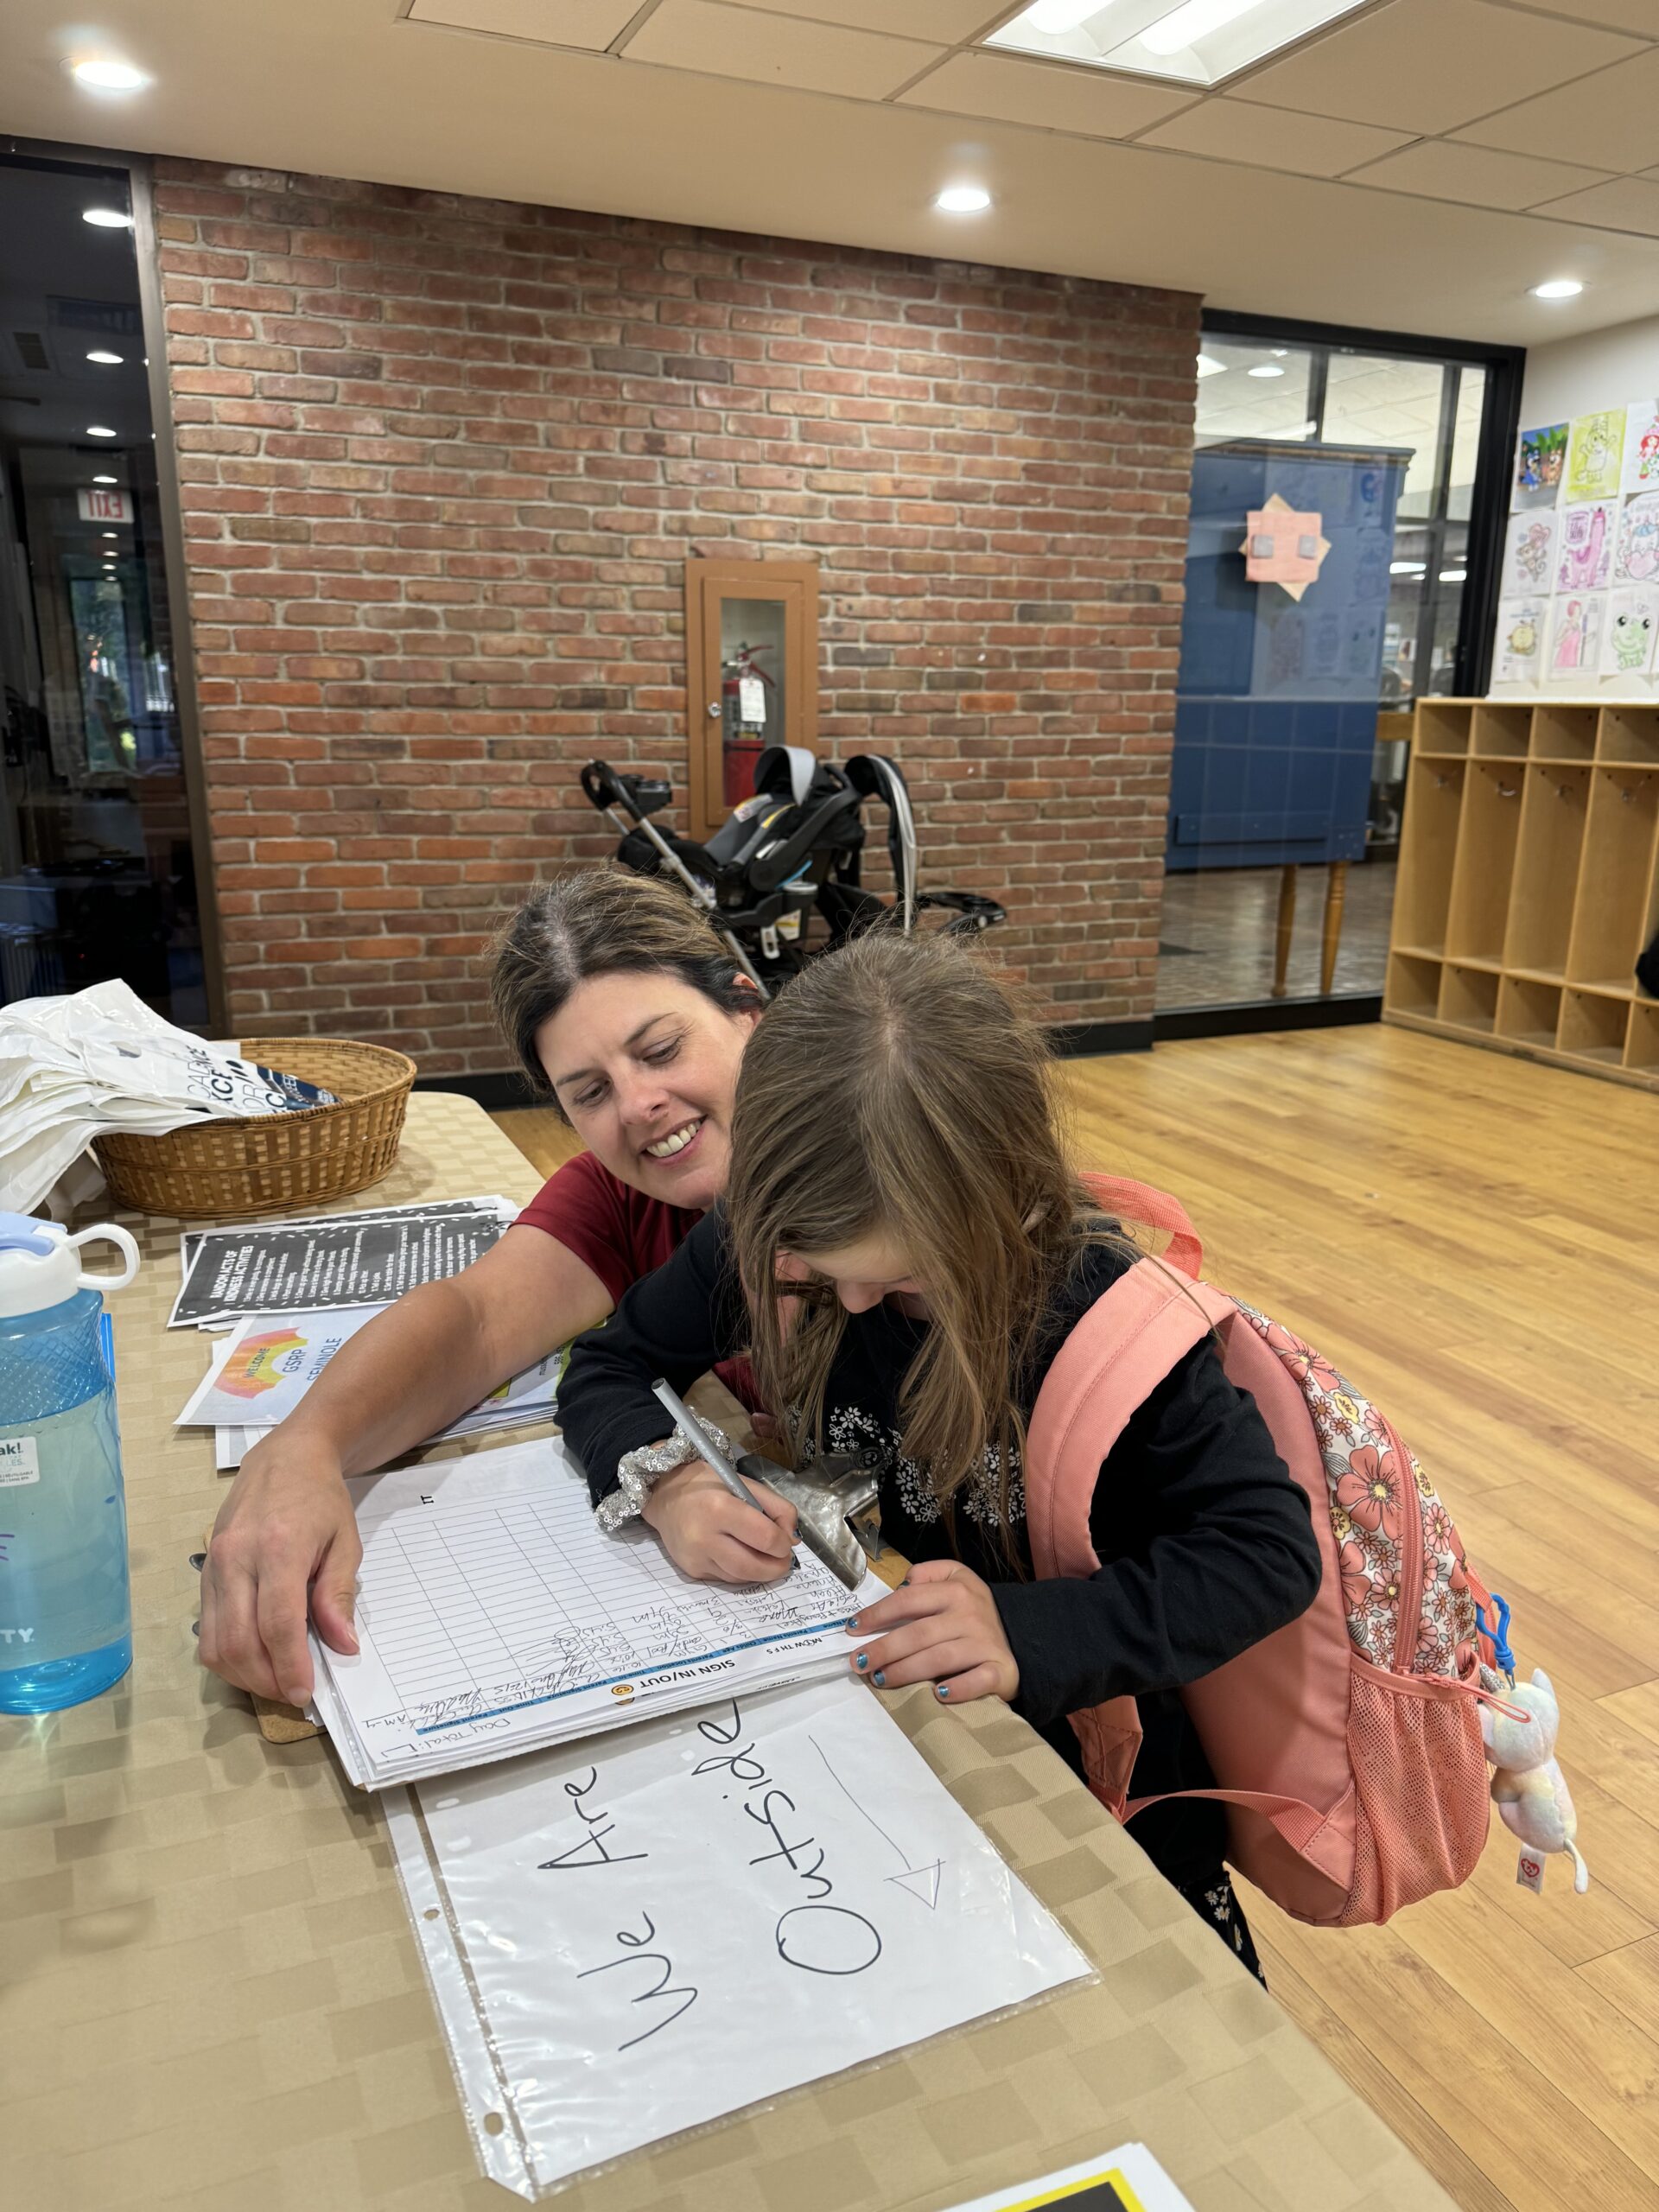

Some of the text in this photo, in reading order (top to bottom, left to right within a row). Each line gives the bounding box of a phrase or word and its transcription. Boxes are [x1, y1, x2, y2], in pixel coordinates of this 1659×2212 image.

[209, 1274, 229, 1298] RANDOM
[219, 1258, 235, 1273] ACTS
[224, 1245, 253, 1301] KINDNESS ACTIVITIES
[244, 1347, 270, 1378] WELCOME
[283, 1349, 307, 1373] GSRP
[307, 1337, 341, 1381] SEMINOLE
[0, 1442, 21, 1455] ak!
[0, 1628, 34, 1643] TY
[640, 1659, 734, 1688] SIGN IN/OUT
[657, 1660, 686, 1669] Location
[546, 1680, 607, 1699] Parent Signature
[423, 1713, 486, 1732] Parent Signature
[468, 1718, 510, 1734] Day
[537, 1765, 648, 1871] Are
[690, 1697, 883, 1976] Outside
[577, 1910, 699, 2053] We
